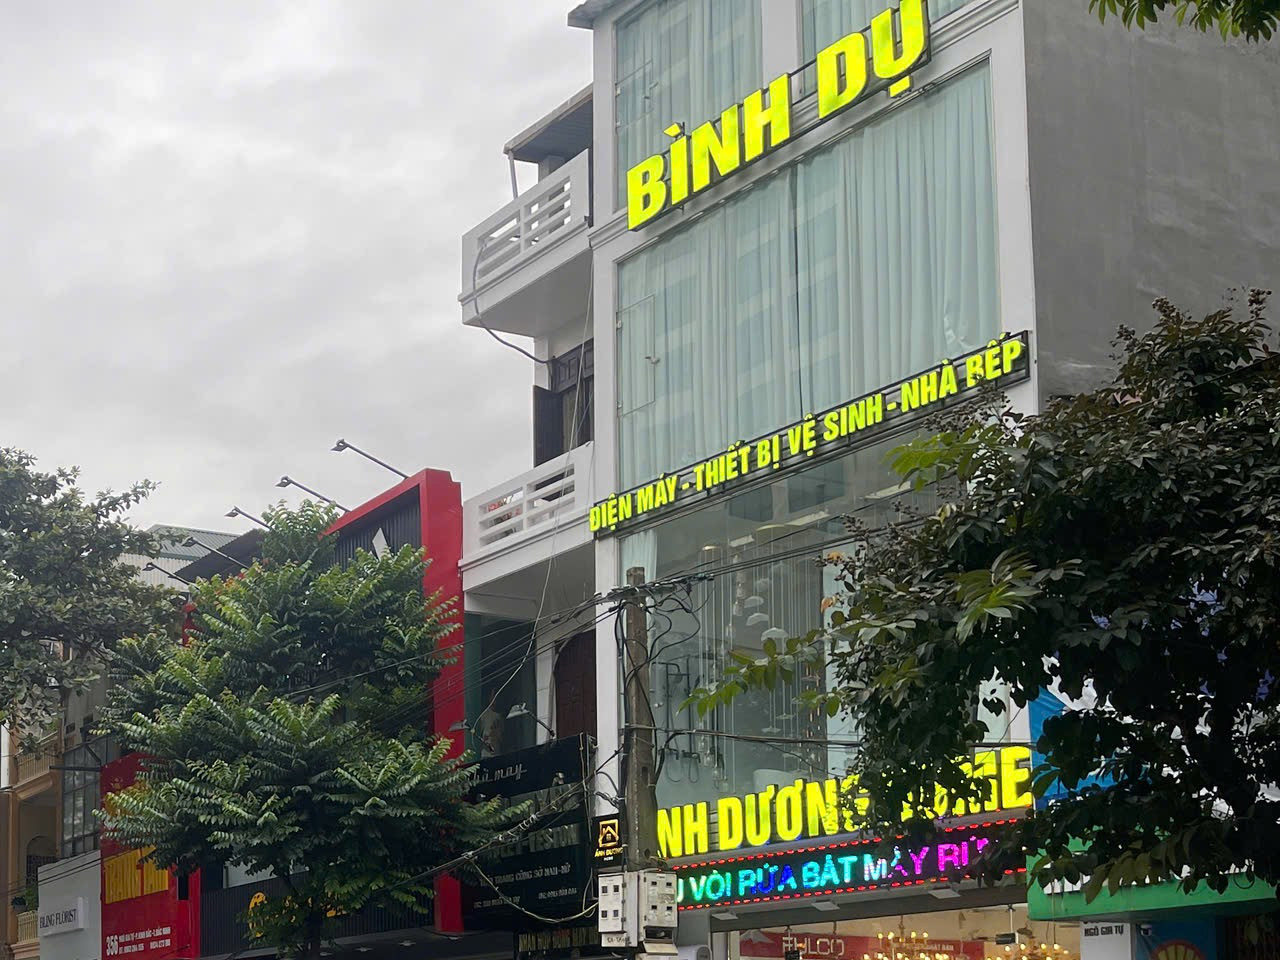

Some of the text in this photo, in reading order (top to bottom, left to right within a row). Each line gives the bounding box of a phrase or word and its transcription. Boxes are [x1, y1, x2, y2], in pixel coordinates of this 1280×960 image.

[626, 0, 927, 231] BÌNH DỤ
[588, 493, 632, 533] ĐIỆN
[636, 473, 678, 514] MÁY
[693, 441, 751, 492] THIẾT
[757, 434, 780, 470] BỊ
[787, 413, 817, 457] VỆ
[823, 393, 883, 442] SINH
[900, 358, 959, 413] NHÀ
[965, 332, 1023, 388] BẾP
[656, 801, 709, 859] NH
